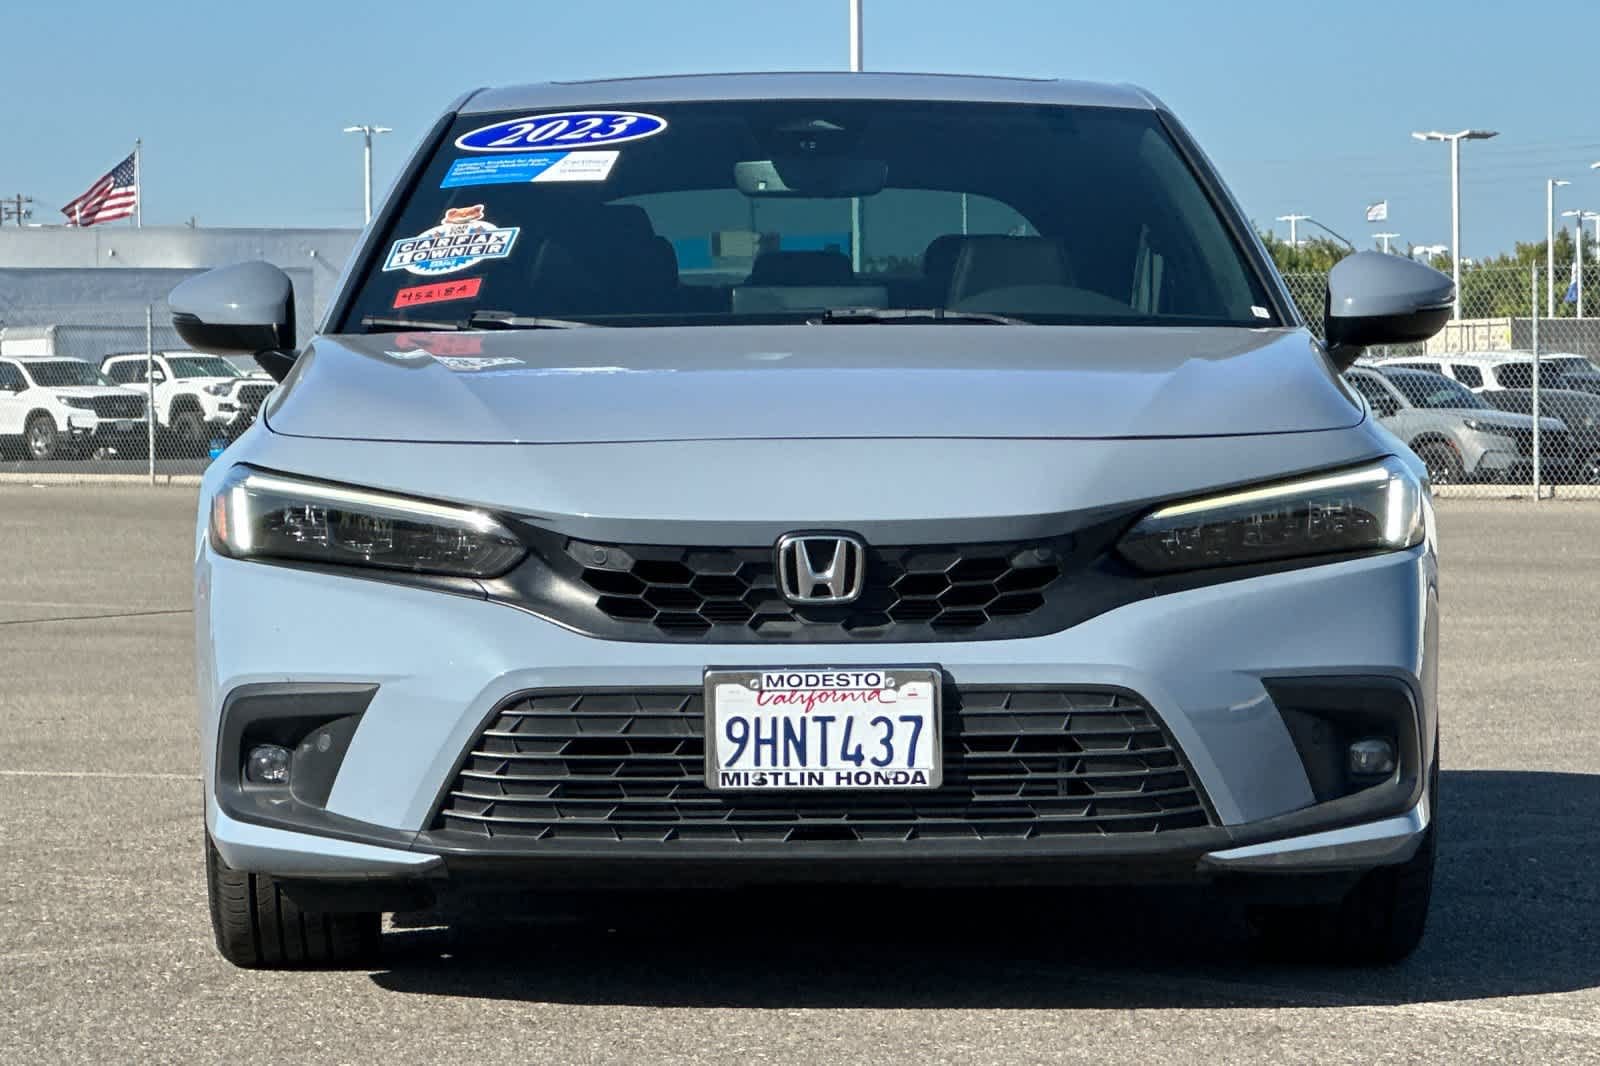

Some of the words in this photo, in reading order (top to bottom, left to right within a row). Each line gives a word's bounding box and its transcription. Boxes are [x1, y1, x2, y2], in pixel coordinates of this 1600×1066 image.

[487, 115, 638, 147] 2023
[400, 234, 506, 253] CARFAX
[412, 244, 504, 261] OWNER
[765, 672, 882, 688] MODESTO
[756, 689, 897, 714] California
[724, 715, 924, 768] 9HNT437
[720, 771, 825, 787] MISTLIN
[835, 771, 928, 786] HONDA
